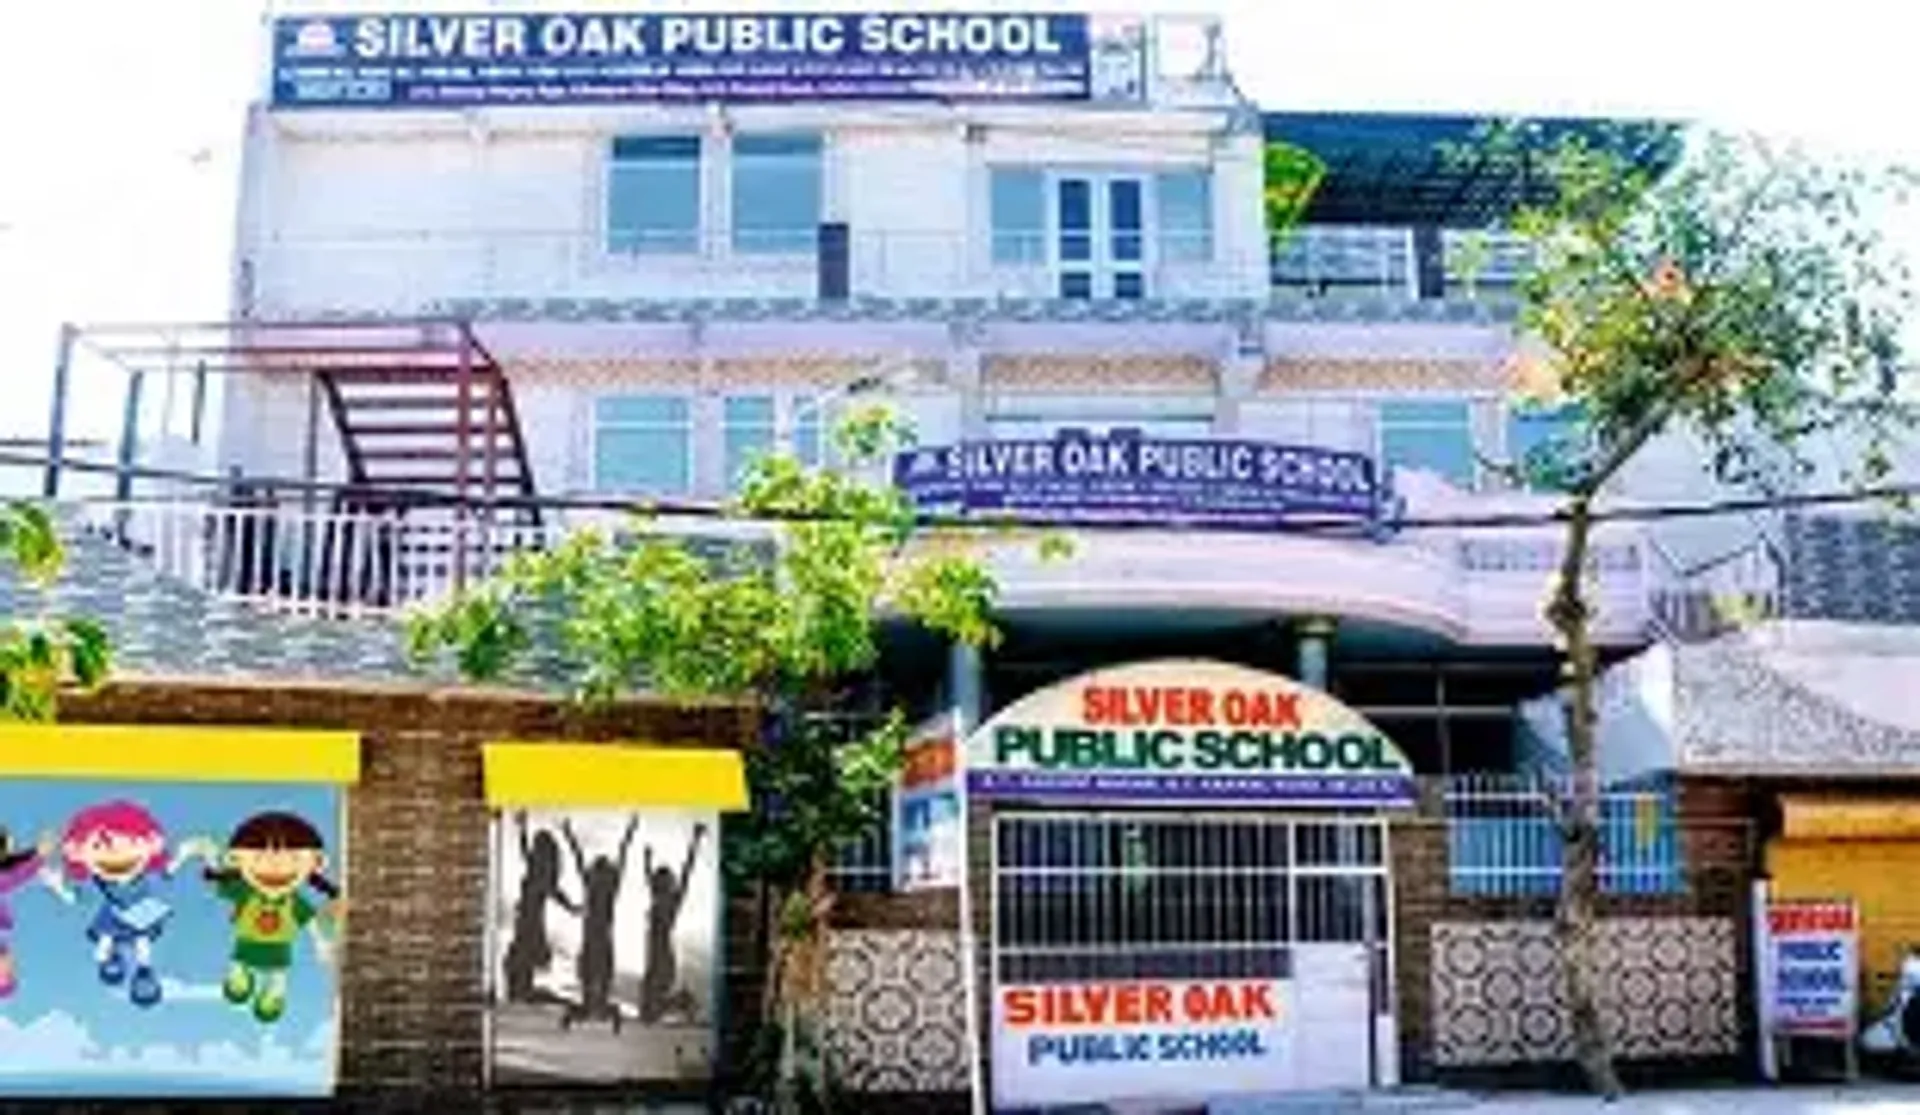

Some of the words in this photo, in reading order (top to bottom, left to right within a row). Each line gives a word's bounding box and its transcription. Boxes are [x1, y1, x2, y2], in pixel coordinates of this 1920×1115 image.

[354, 17, 527, 57] SILVER
[542, 16, 647, 56] OAK
[662, 16, 844, 53] PUBLIC
[859, 17, 1061, 53] SCHOOL
[947, 444, 1054, 478] SILVER
[1060, 441, 1133, 476] OAK
[1137, 445, 1253, 479] PUBLIC
[1259, 452, 1371, 492] SCHOOL
[1081, 686, 1215, 726] SILVER
[1220, 687, 1302, 728] OAK
[994, 727, 1182, 770] PUBLIC
[1193, 730, 1400, 771] SCHOOL
[1003, 985, 1173, 1024] SILVER
[1183, 983, 1276, 1022] OAK
[1027, 1031, 1151, 1066] PUBLIC
[1157, 1028, 1266, 1061] SCHOOL
